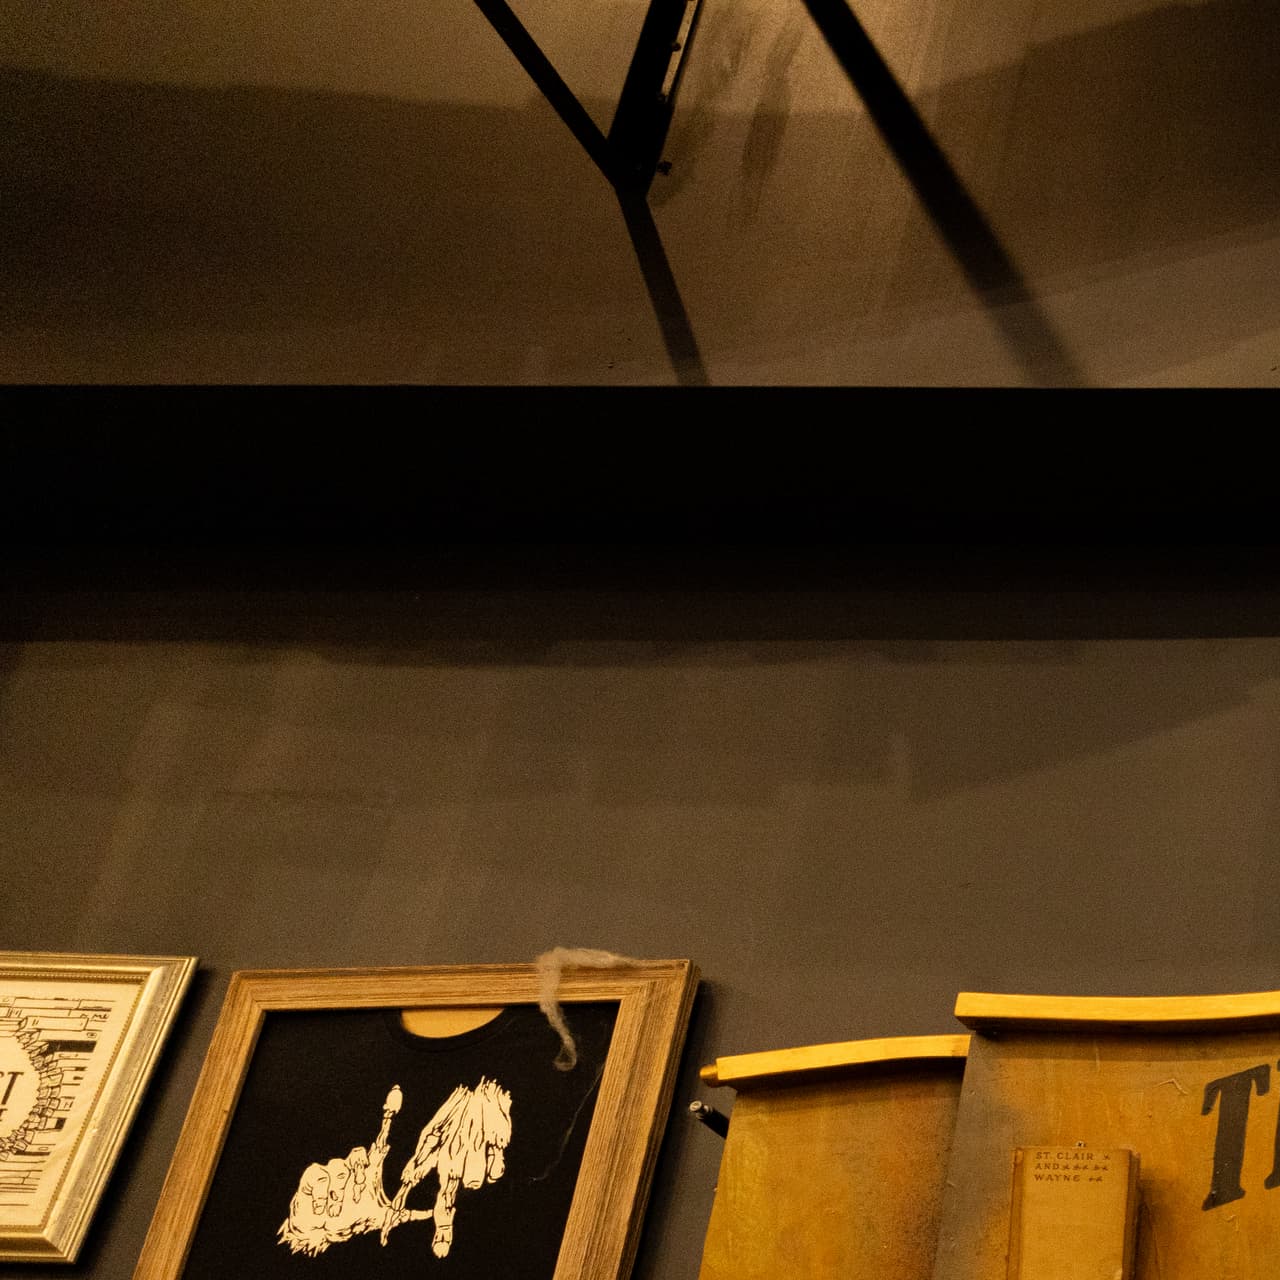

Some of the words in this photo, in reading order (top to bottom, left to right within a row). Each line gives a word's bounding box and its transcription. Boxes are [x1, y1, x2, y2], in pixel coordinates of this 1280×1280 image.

[1056, 1152, 1094, 1161] CLAIR
[1035, 1162, 1060, 1171] AND
[1034, 1174, 1081, 1183] WAYNE
